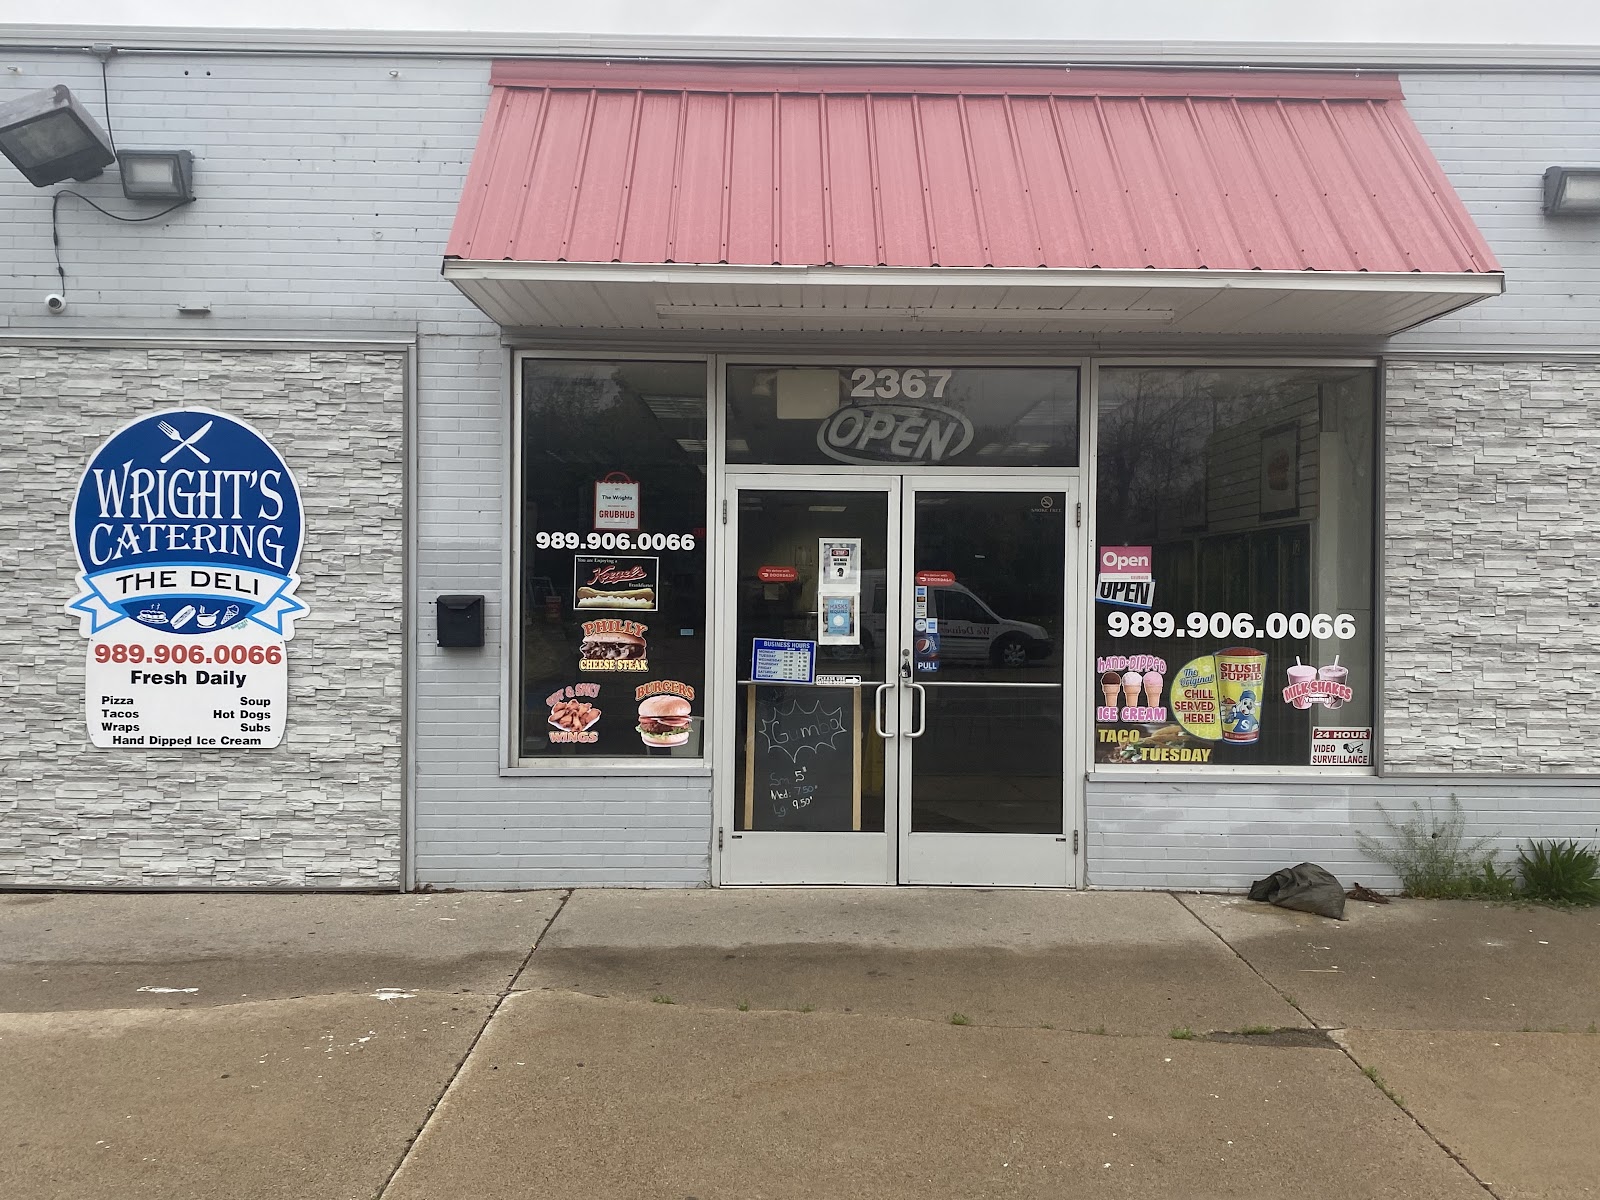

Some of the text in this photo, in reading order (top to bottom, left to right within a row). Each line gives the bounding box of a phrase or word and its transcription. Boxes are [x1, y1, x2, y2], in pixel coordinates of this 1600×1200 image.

[850, 368, 952, 399] 2367
[827, 408, 958, 461] OPEN
[93, 459, 284, 523] WRIGHT'S
[599, 510, 636, 519] GRUBHUB
[89, 523, 285, 569] CATERING
[535, 531, 695, 551] 989.906.0066
[1102, 551, 1149, 571] Open
[116, 571, 259, 596] THE DELI
[1100, 582, 1151, 605] OPEN
[583, 619, 648, 637] PHILLY
[1107, 611, 1356, 639] 989.906.0066
[763, 640, 791, 648] BUSINESS
[94, 644, 282, 664] 989.906.0066
[580, 659, 648, 671] CHEESE STEAK
[917, 662, 937, 670] PULL
[1220, 663, 1262, 673] SLUSH
[1184, 668, 1199, 678] The
[131, 671, 247, 688] Fresh Daily
[635, 680, 695, 701] BURGERS
[1184, 689, 1215, 699] CHILL
[1283, 680, 1352, 702] MILK SHAKES
[102, 696, 134, 706] Pizza
[240, 697, 271, 708] Soup
[1174, 701, 1215, 711] SERVED
[102, 709, 139, 719] Tacos
[213, 710, 271, 721] Hot Dogs
[1097, 707, 1167, 722] ICE CREAM
[1184, 713, 1215, 724] HERE!
[102, 722, 140, 733] Wraps
[240, 723, 271, 732] Subs
[772, 714, 840, 744] Gumbo
[1240, 719, 1250, 730] S
[112, 736, 262, 748] Hand Dipped Ice Cream
[549, 731, 599, 743] WINGS
[1098, 729, 1140, 743] TACO
[1313, 744, 1336, 753] VIDEO
[1140, 748, 1211, 762] TUESDAY
[1312, 755, 1368, 764] SURVEILLANCE
